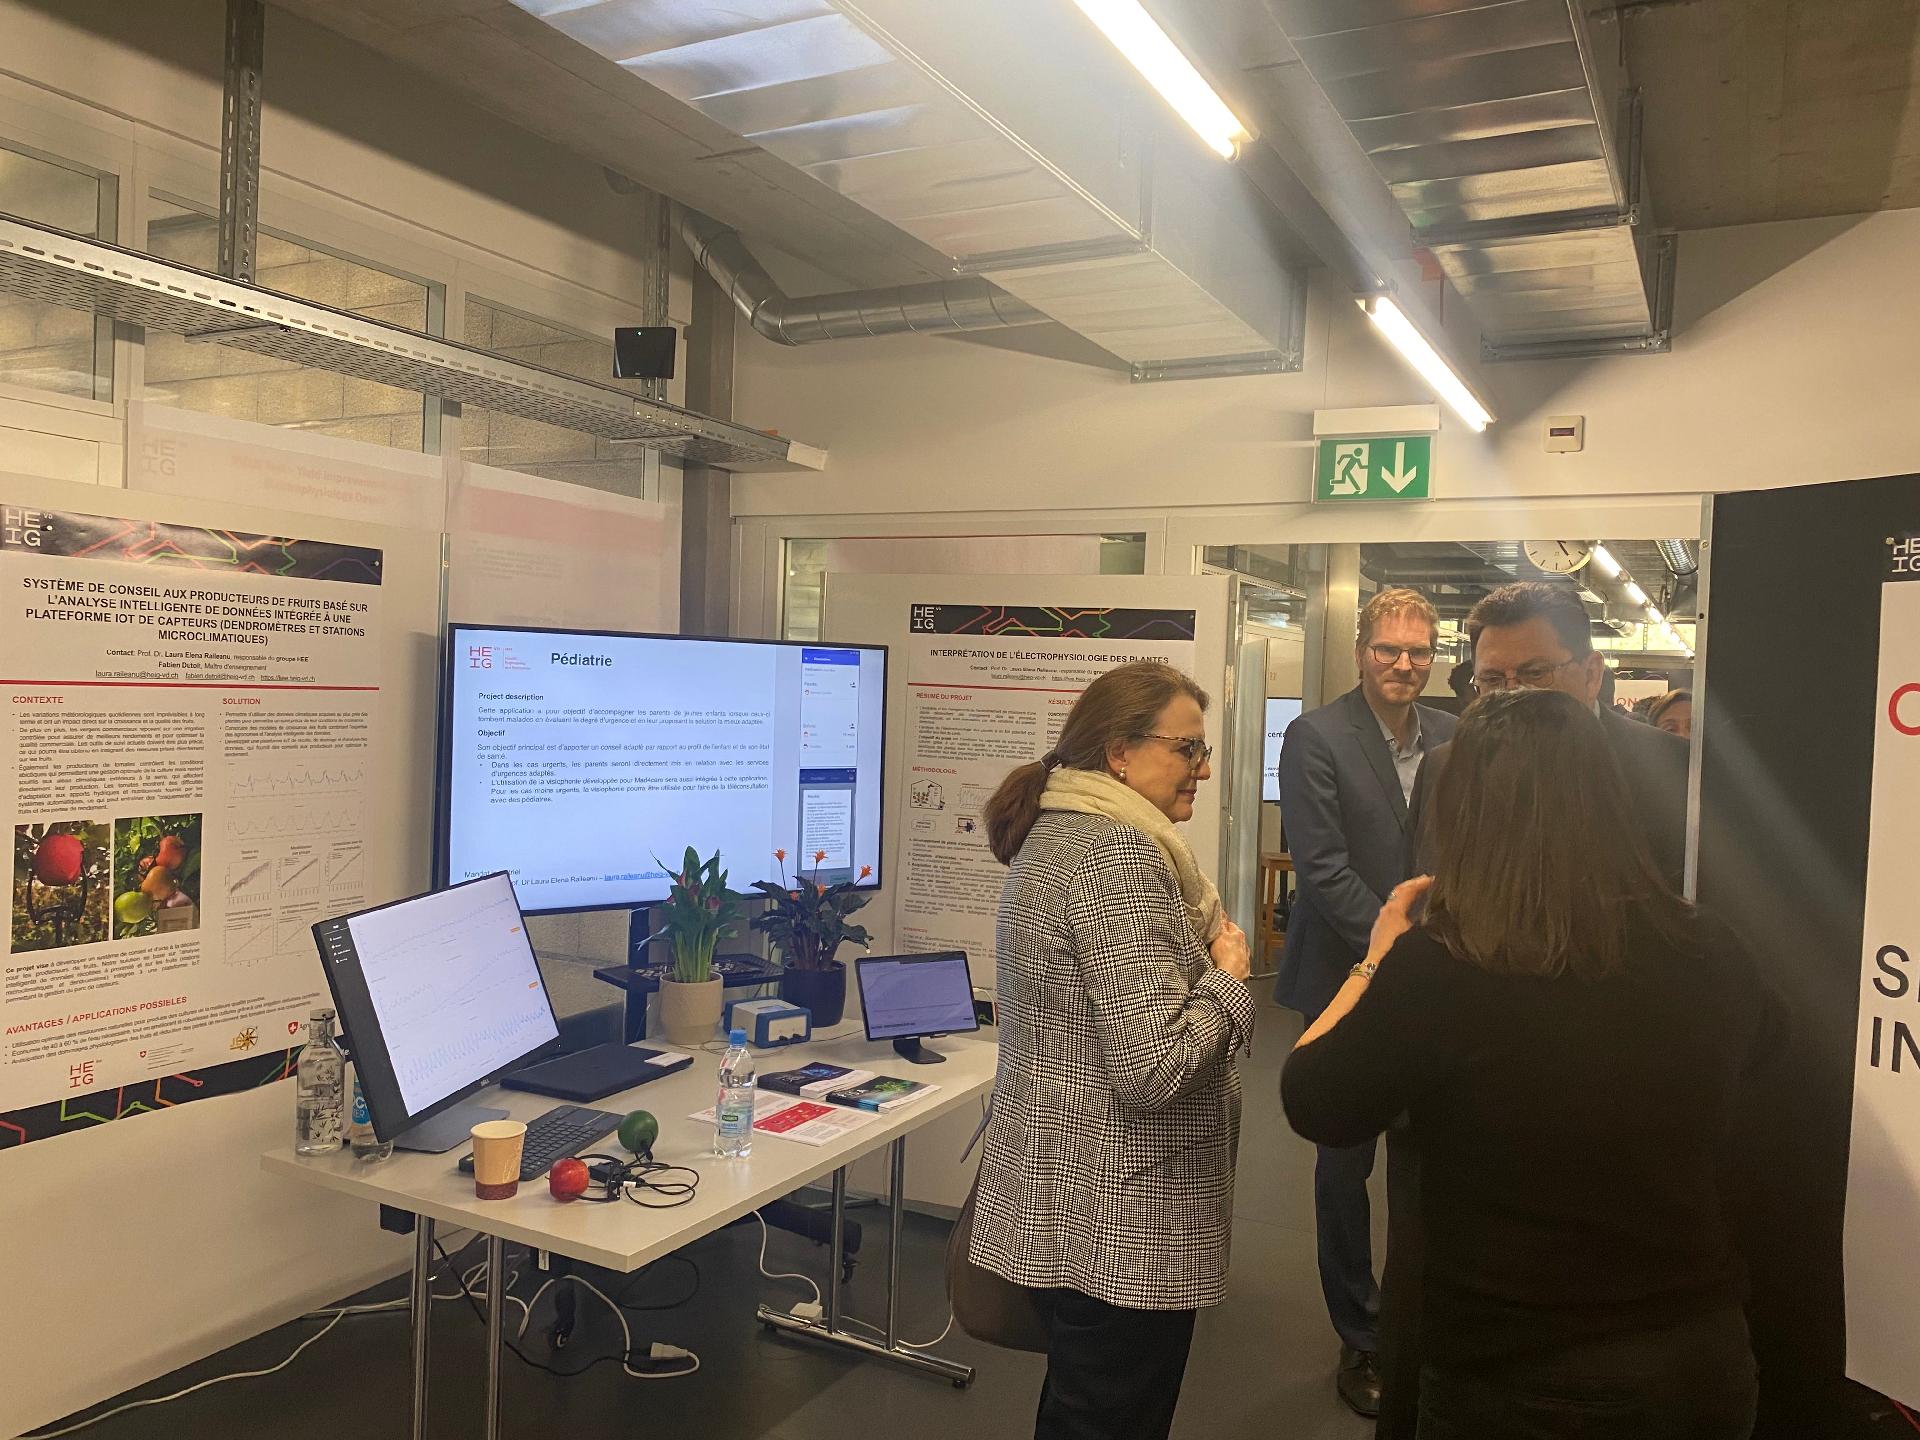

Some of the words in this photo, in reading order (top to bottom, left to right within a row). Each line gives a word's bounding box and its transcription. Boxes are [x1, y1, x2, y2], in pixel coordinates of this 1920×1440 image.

[5, 508, 41, 529] HE
[5, 527, 41, 547] IG
[23, 577, 85, 592] SYSTÈME
[88, 582, 105, 593] DE
[109, 584, 161, 597] CONSEIL
[163, 588, 188, 600] AUX
[190, 590, 269, 606] PRODUCTEURS
[272, 596, 285, 607] DE
[287, 598, 321, 609] FRUITS
[323, 599, 348, 611] BASÉ
[349, 602, 368, 613] SUR
[120, 599, 202, 614] INTELLIGENTE
[205, 605, 220, 615] DE
[222, 606, 272, 619] DONNÉES
[274, 609, 322, 622] INTÉGRÉE
[323, 611, 331, 622] À
[333, 614, 351, 623] UNE
[914, 606, 935, 618] HE
[26, 608, 112, 623] PLATEFORME
[115, 613, 136, 624] IOT
[139, 614, 154, 625] DE
[158, 616, 218, 629] CAPTEURS
[220, 619, 306, 633] (DENDROMÈTRES
[309, 625, 320, 635] ET
[323, 626, 365, 637] STATIONS
[913, 618, 934, 630] IG
[158, 630, 268, 647] MICROCLIMATIQUES)
[469, 646, 493, 657] HE
[930, 649, 995, 659] INTERPRÉTATION
[996, 651, 1008, 659] DE
[1009, 650, 1108, 662] L'ÉLECTROPHYSIOLOGIE
[1110, 655, 1128, 663] DES
[275, 656, 296, 664] groupe
[469, 657, 492, 669] IG
[551, 652, 612, 667] Pédiatrie
[12, 696, 64, 704] CONTEXTE
[222, 697, 261, 705] SOLUTION
[478, 692, 504, 701] Project
[505, 693, 544, 701] description
[916, 691, 940, 700] RÉSUMÉ
[951, 693, 973, 701] PROJET
[478, 706, 496, 714] Cette
[499, 707, 535, 716] application
[563, 708, 586, 716] objectif
[477, 729, 506, 737] Objectif
[492, 744, 516, 752] objectif
[518, 744, 545, 752] principal
[558, 744, 590, 752] d'apporter
[491, 761, 510, 769] Dans
[542, 761, 568, 770] urgents,
[584, 761, 608, 769] parents
[912, 766, 957, 775] MÉTHODOLOGIE
[491, 770, 528, 779] d'urgences
[530, 877, 550, 885] Laura
[570, 875, 599, 883] Raileanu
[16, 965, 35, 974] projet
[1872, 944, 1920, 1002] S
[6, 1018, 64, 1036] AVANTAGES
[72, 1004, 138, 1024] APPLICATIONS
[139, 996, 188, 1011] POSSIBLES
[70, 1060, 94, 1076] HE
[69, 1074, 94, 1088] IG
